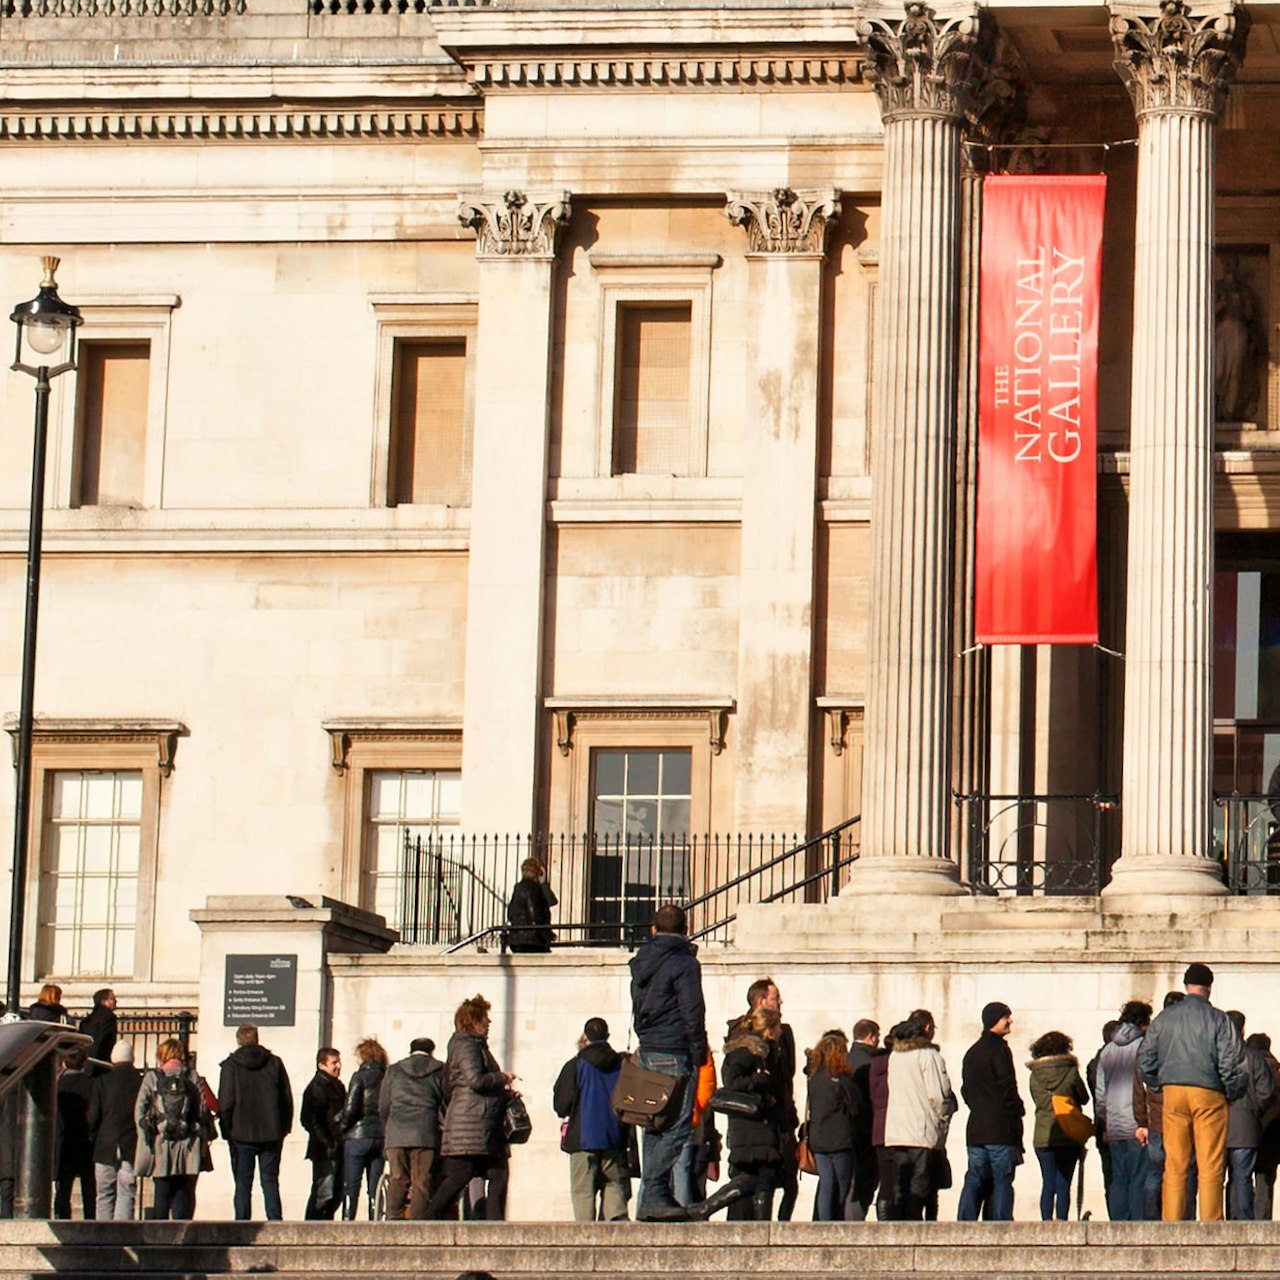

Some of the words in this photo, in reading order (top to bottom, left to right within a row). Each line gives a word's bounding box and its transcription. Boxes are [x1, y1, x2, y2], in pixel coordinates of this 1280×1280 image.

[995, 365, 1009, 409] THE
[1014, 245, 1046, 464] NATIONAL
[1048, 245, 1086, 463] GALLERY
